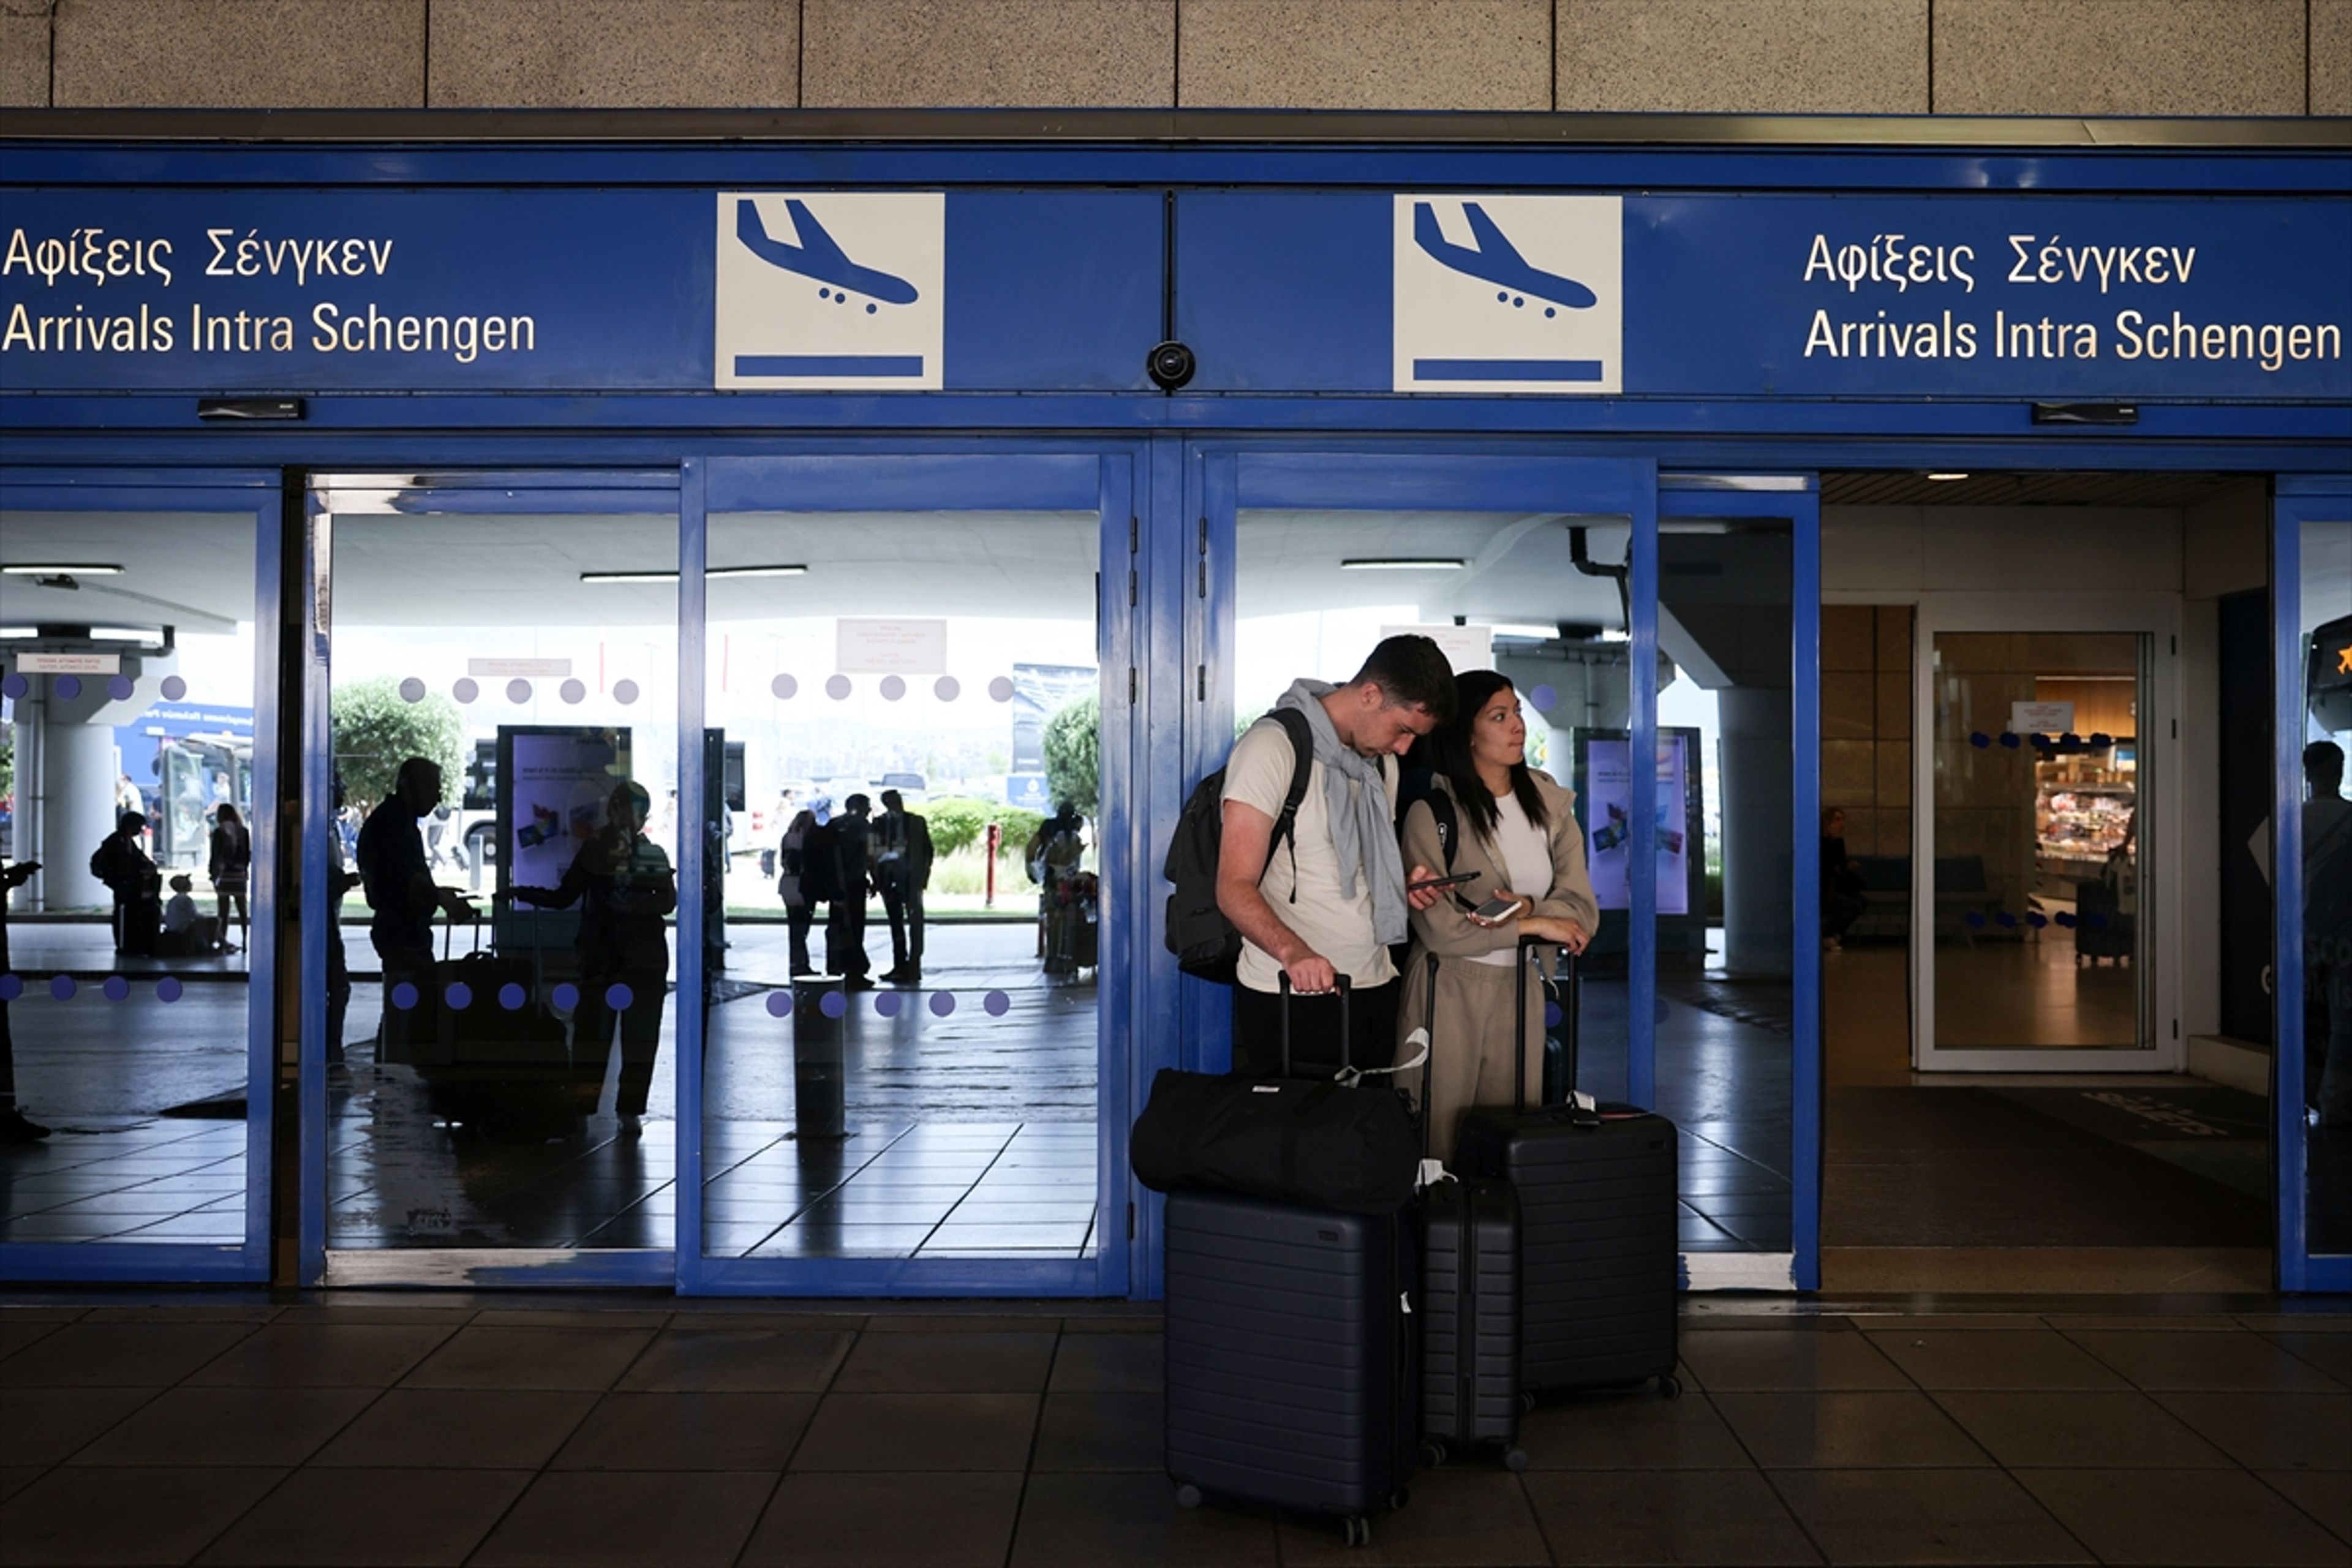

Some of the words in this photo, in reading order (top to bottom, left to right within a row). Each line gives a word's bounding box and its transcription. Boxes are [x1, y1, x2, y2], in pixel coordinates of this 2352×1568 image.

[2, 228, 172, 287] Αφίξεις
[205, 228, 393, 286] Σένγκεν
[1804, 234, 1975, 293] Αφίξεις
[2008, 235, 2196, 293] Σένγκεν
[1, 303, 173, 352] Arrivals
[193, 303, 293, 352] Intra
[312, 303, 534, 363] Schengen
[1804, 309, 1977, 358] Arrivals
[1996, 310, 2097, 358] Intra
[2116, 310, 2340, 371] Schengen
